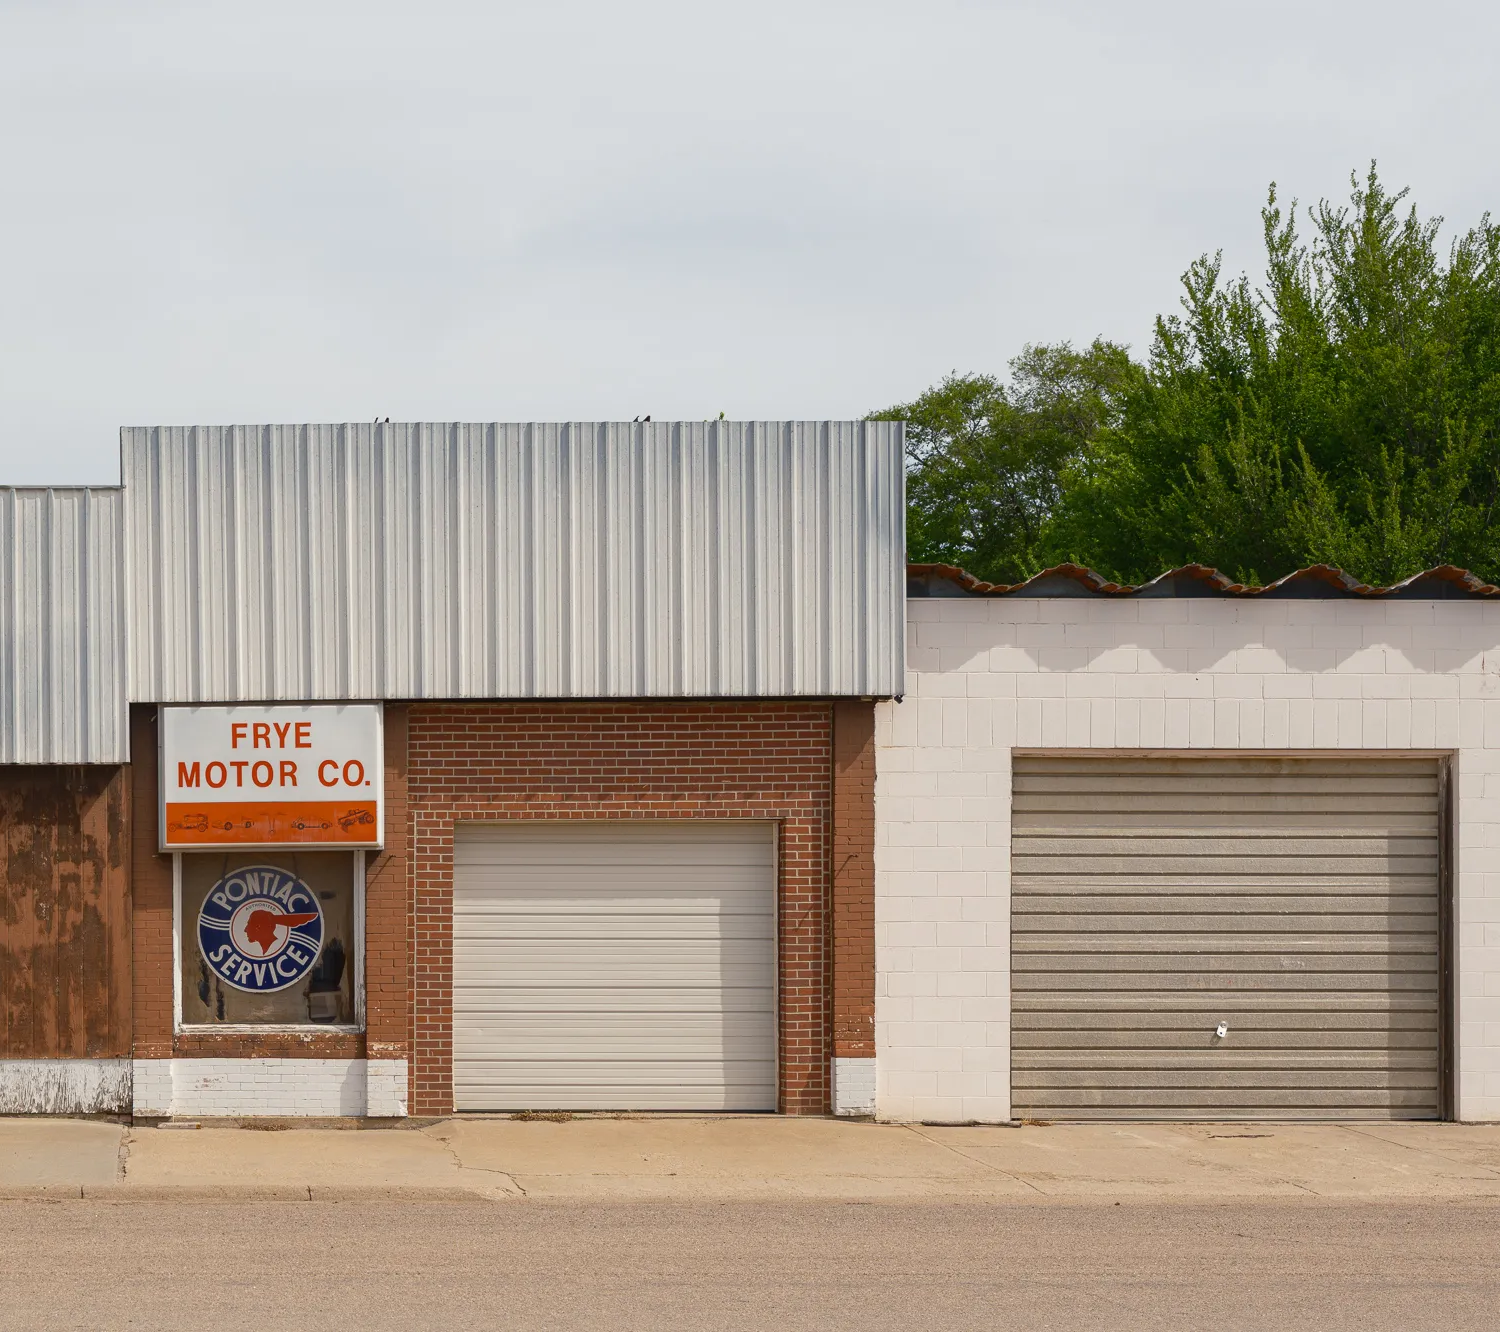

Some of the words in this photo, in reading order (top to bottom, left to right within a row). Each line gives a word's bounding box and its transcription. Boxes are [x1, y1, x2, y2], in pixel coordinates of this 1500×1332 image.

[231, 722, 312, 749] FRYE
[177, 760, 298, 788] MOTOR
[317, 759, 371, 788] CO.
[212, 872, 309, 913] PONTIAC
[245, 902, 277, 912] AUTHORIZED
[209, 944, 309, 986] SERVICE
